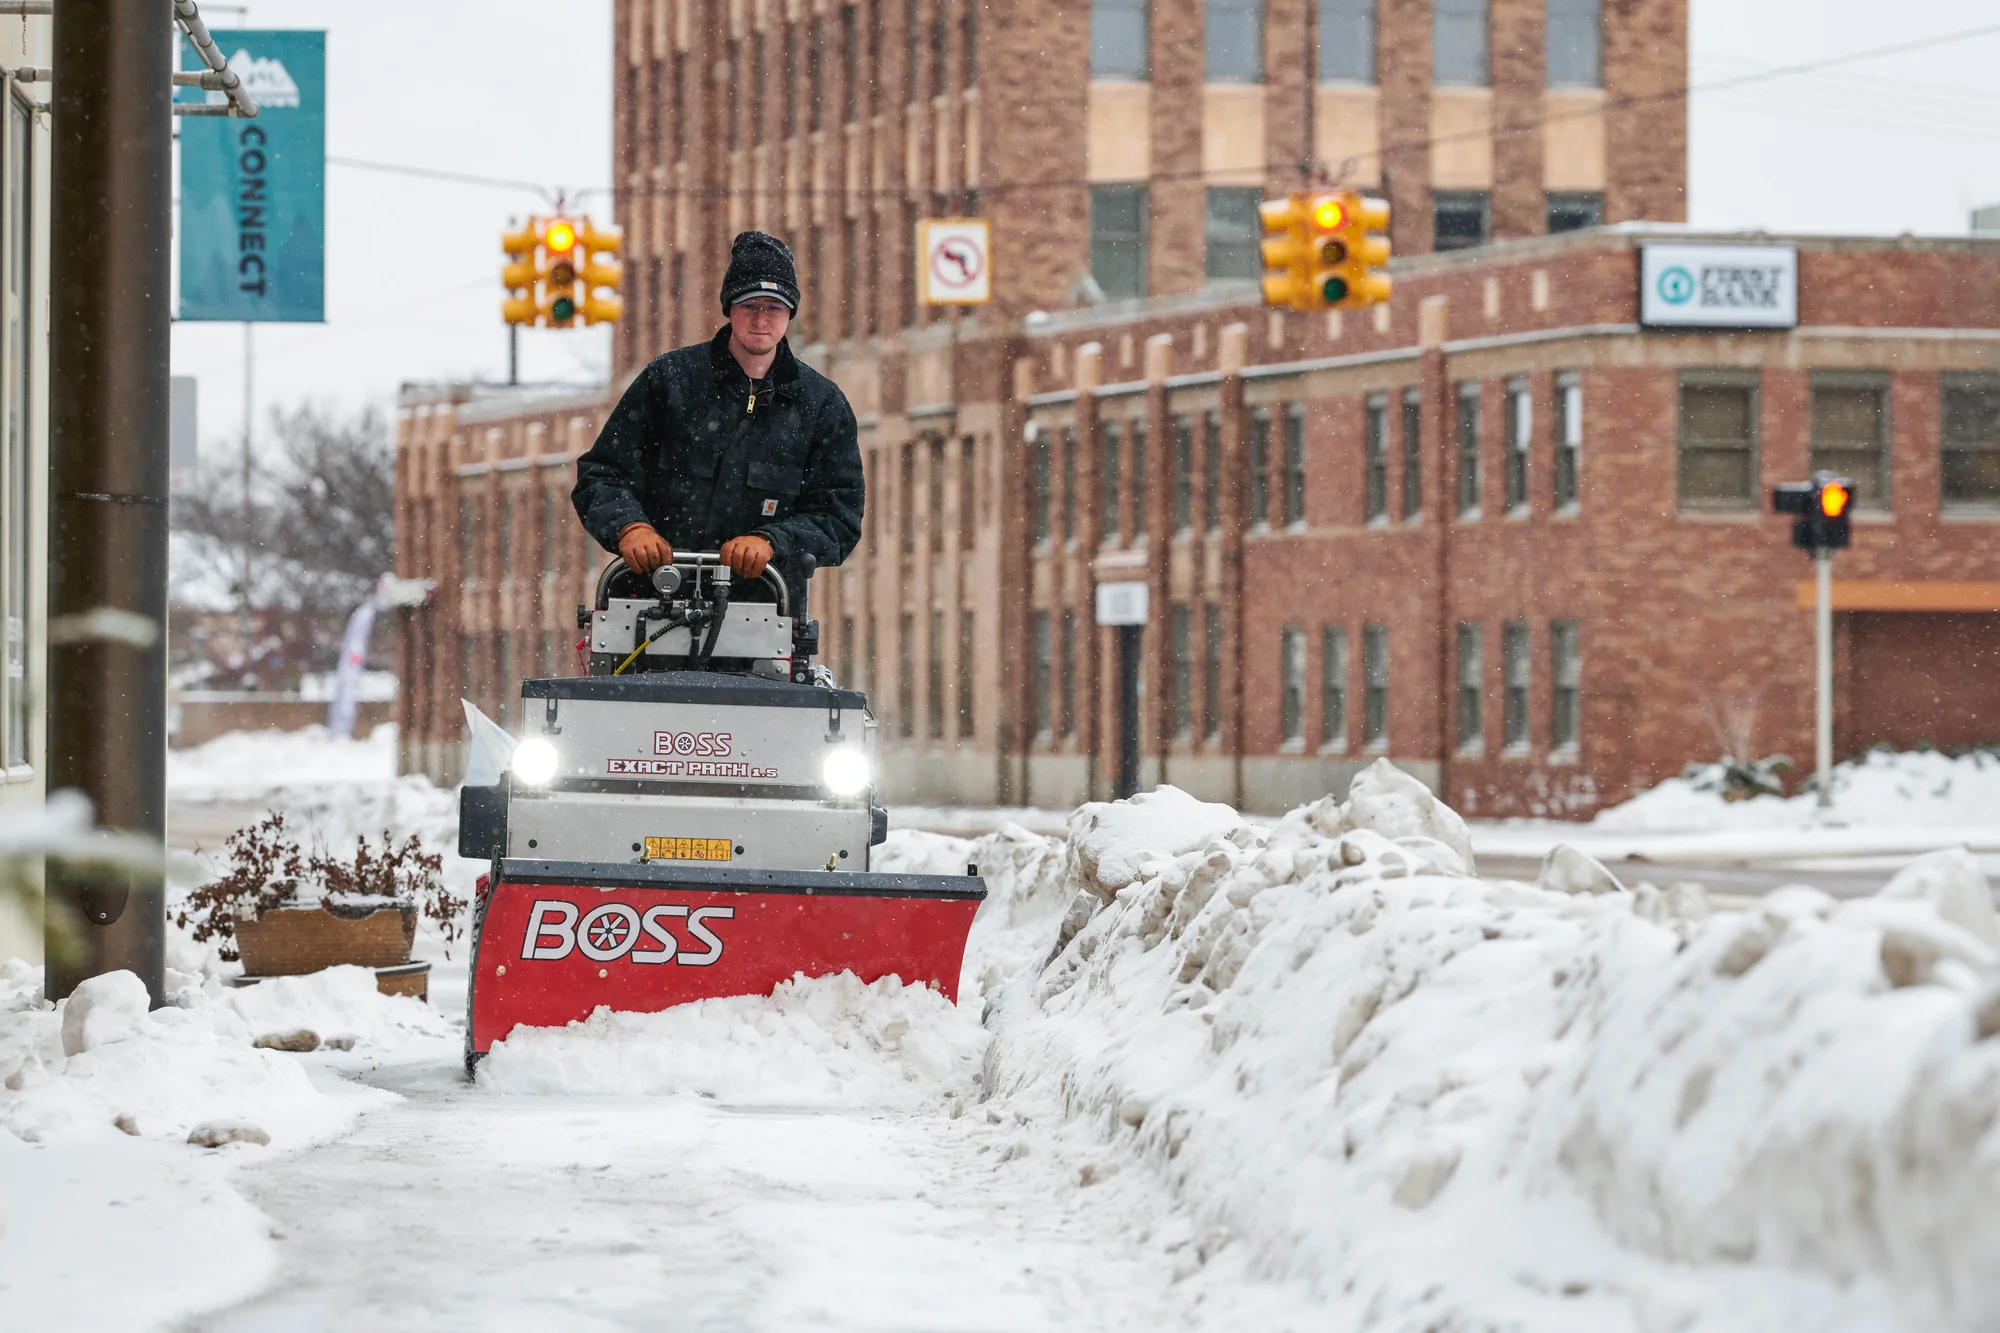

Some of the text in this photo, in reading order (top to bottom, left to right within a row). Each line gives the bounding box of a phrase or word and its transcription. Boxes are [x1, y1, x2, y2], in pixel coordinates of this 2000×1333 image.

[240, 125, 267, 297] CONNECT
[1700, 266, 1784, 285] FIRST
[1700, 287, 1779, 308] BANK
[654, 731, 732, 757] BOSS
[607, 758, 778, 778] EXACT PATH 1.5
[520, 900, 735, 967] BOSS
